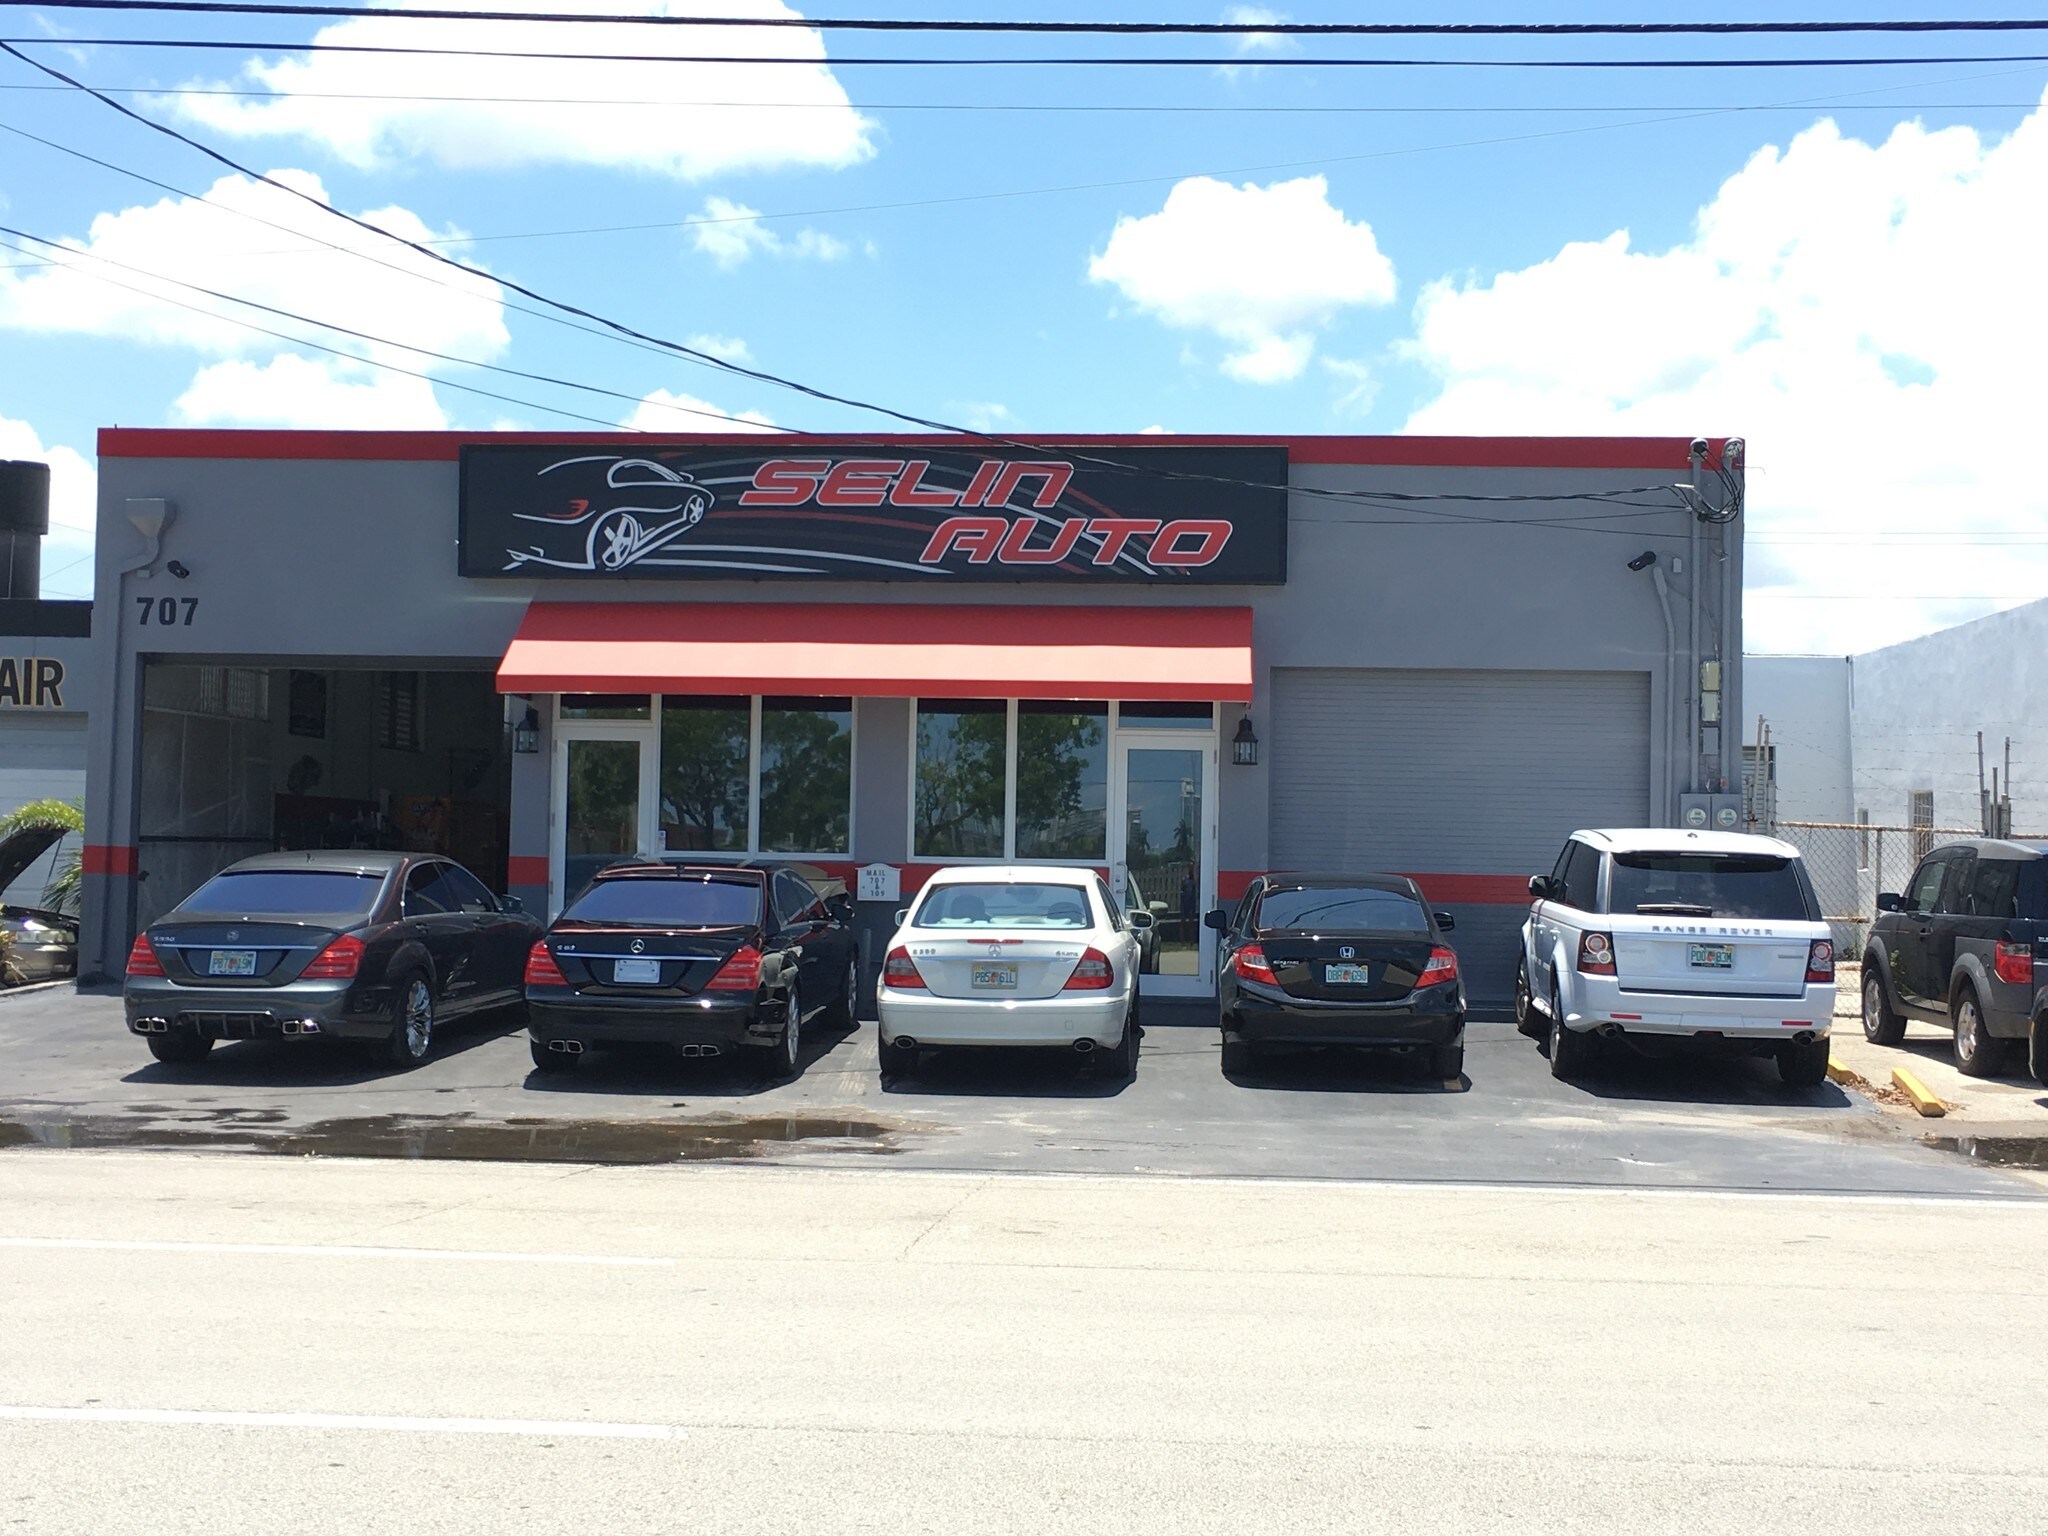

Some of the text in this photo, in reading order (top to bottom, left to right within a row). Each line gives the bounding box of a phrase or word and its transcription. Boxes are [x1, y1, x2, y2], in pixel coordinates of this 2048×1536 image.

[738, 459, 1074, 508] SELIN
[918, 516, 1233, 567] AUTO
[136, 597, 199, 626] 707
[0, 658, 64, 707] AIR
[1652, 925, 1773, 936] RANGE ROVER
